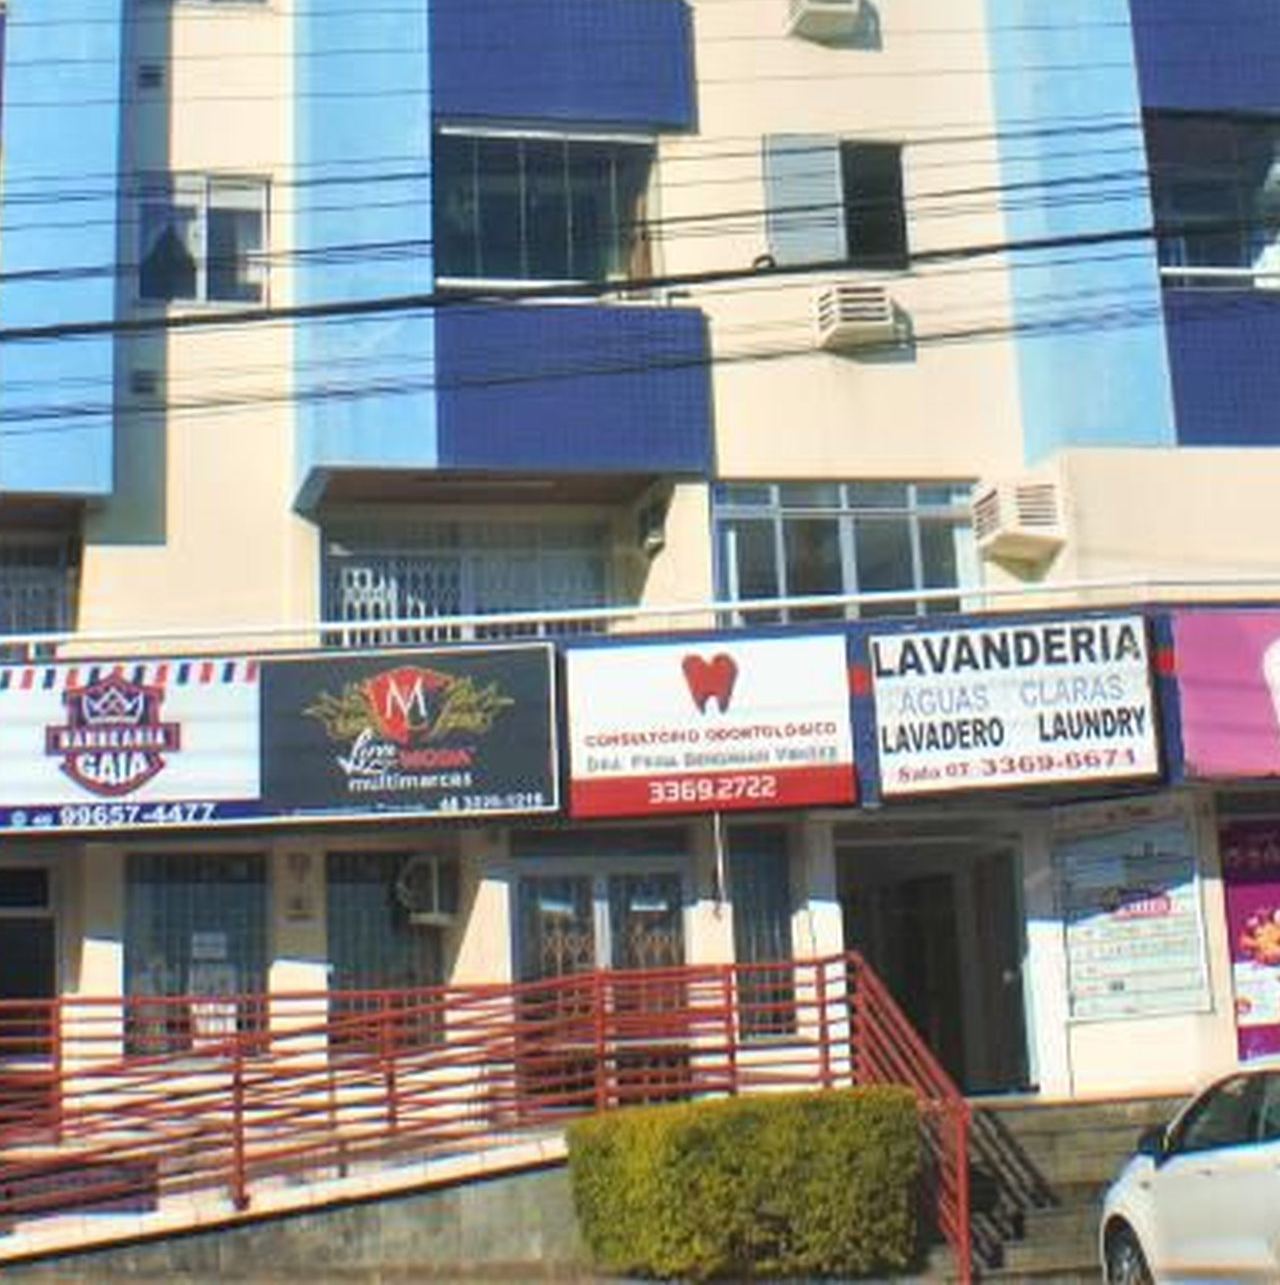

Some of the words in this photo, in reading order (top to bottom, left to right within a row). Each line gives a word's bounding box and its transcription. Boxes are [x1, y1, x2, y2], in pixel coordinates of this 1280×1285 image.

[873, 624, 1140, 677] LAVANDERIA
[1020, 674, 1124, 708] CLARAS
[882, 717, 1005, 754] LAVADERO
[1038, 705, 1146, 742] LAUNDRY
